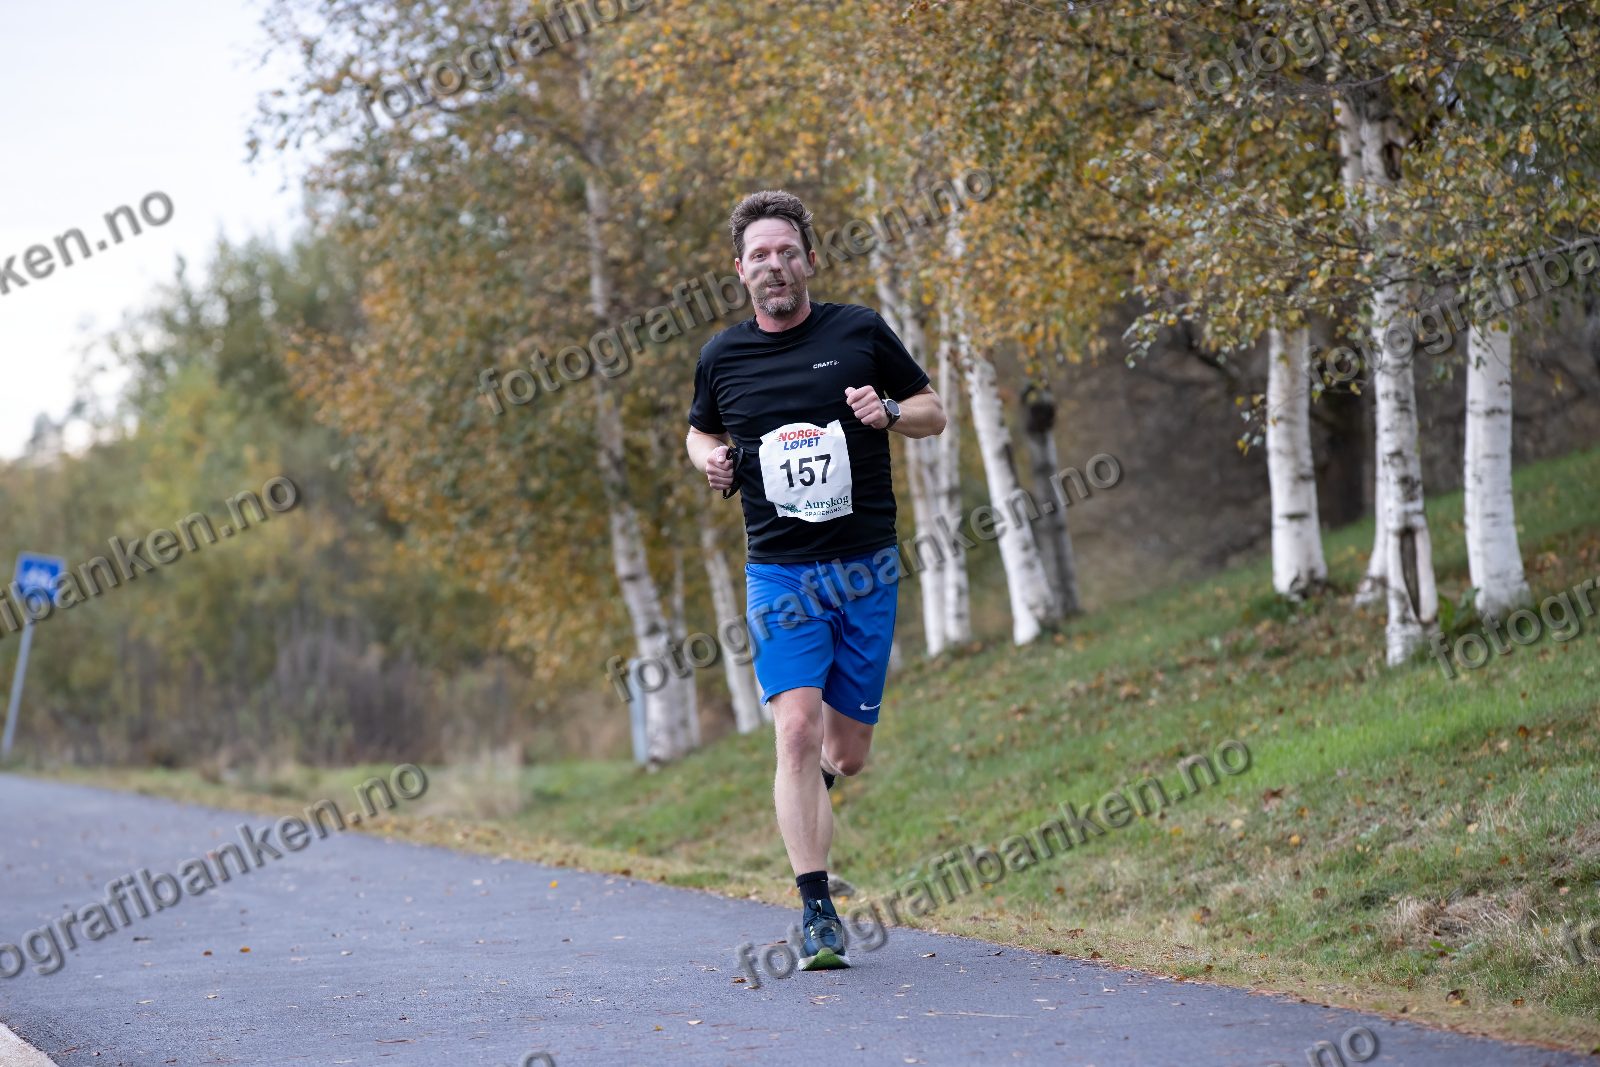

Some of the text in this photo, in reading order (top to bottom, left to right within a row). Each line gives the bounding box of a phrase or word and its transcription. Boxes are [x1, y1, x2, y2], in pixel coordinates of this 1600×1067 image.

[784, 437, 820, 451] LØPET
[780, 453, 831, 488] 157
[804, 495, 849, 510] Aurskog
